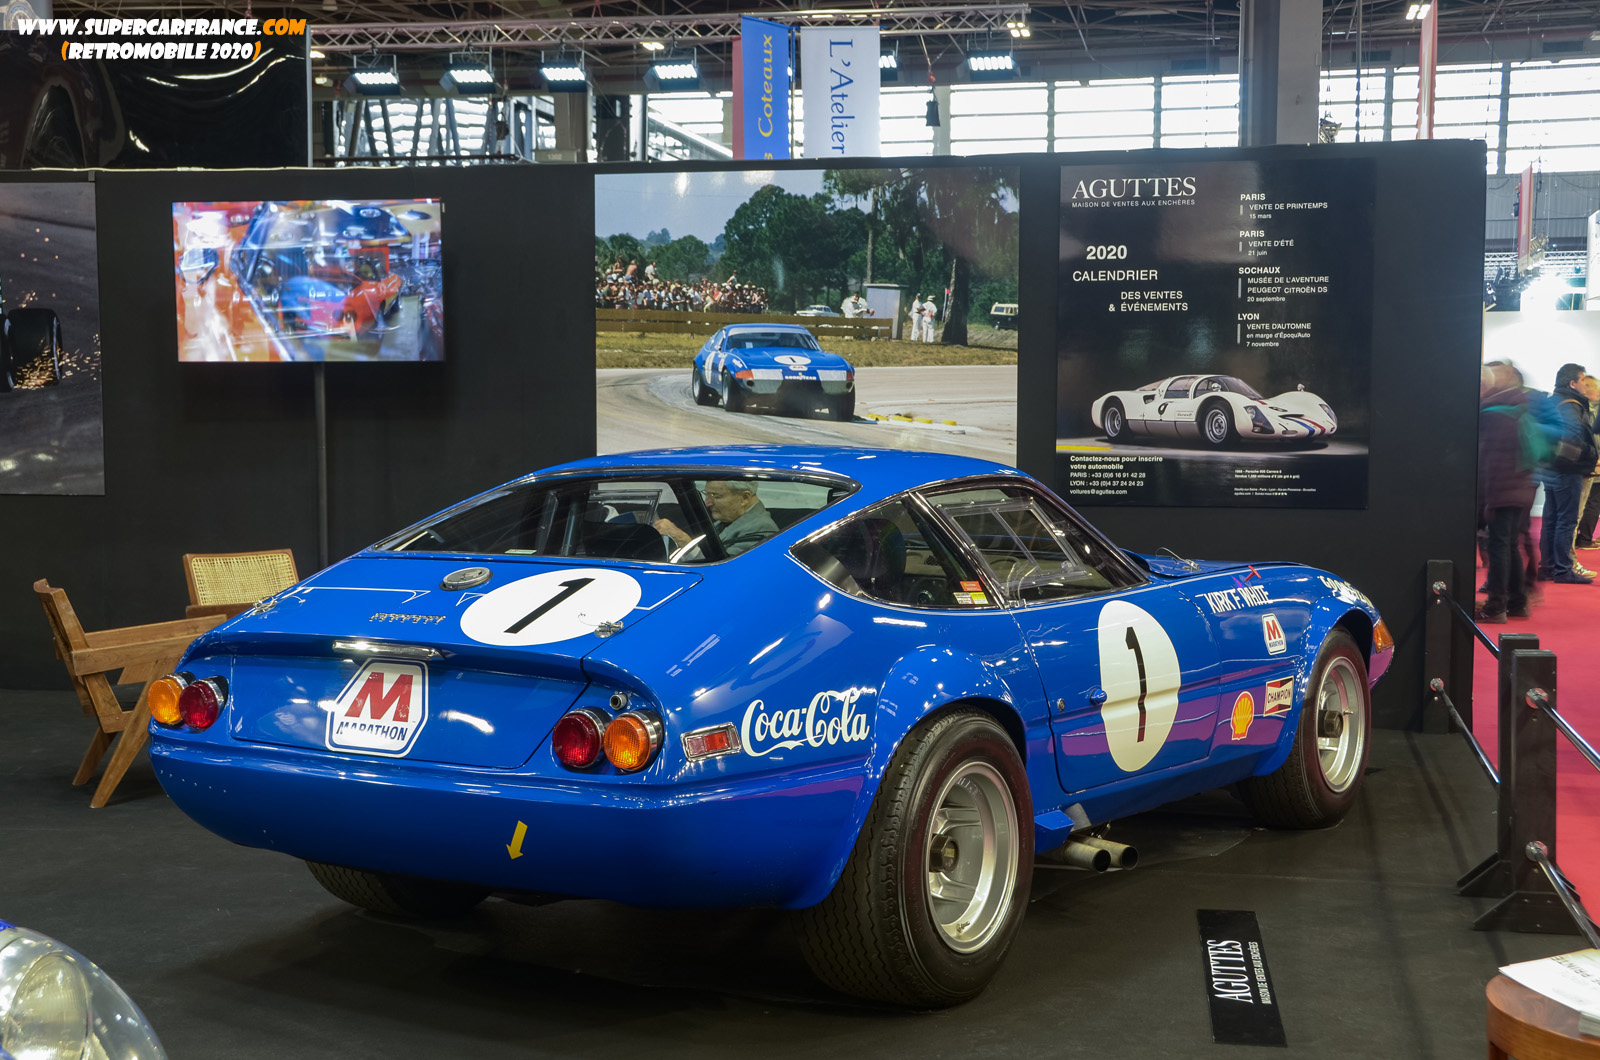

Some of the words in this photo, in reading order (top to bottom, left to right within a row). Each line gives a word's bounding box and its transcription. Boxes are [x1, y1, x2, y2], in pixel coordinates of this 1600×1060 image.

[758, 34, 773, 138] Coteaux
[829, 39, 855, 154] L'Atelier
[1072, 176, 1196, 199] AGUTTES
[1240, 193, 1266, 201] PARIS
[1239, 230, 1265, 238] PARIS
[1273, 239, 1295, 247] D'ÉTÉ
[1086, 245, 1128, 260] 2020
[1072, 269, 1158, 282] CALENDRIER
[1247, 276, 1272, 284] MUSÉE
[1121, 291, 1141, 300] DES
[1143, 290, 1183, 300] VENTES
[1108, 304, 1116, 312] &
[1120, 302, 1189, 312] ÉVÉNEMENTS
[1237, 313, 1260, 321] LYON
[504, 577, 596, 635] 1
[1203, 590, 1237, 614] KIRK
[1237, 584, 1273, 607] WHITE
[1266, 619, 1282, 640] M
[1125, 626, 1147, 743] 1
[344, 671, 413, 723] M
[1267, 689, 1291, 704] CHAMPION
[741, 690, 870, 757] Coca-Cola
[1206, 939, 1254, 1004] AGUTTES
